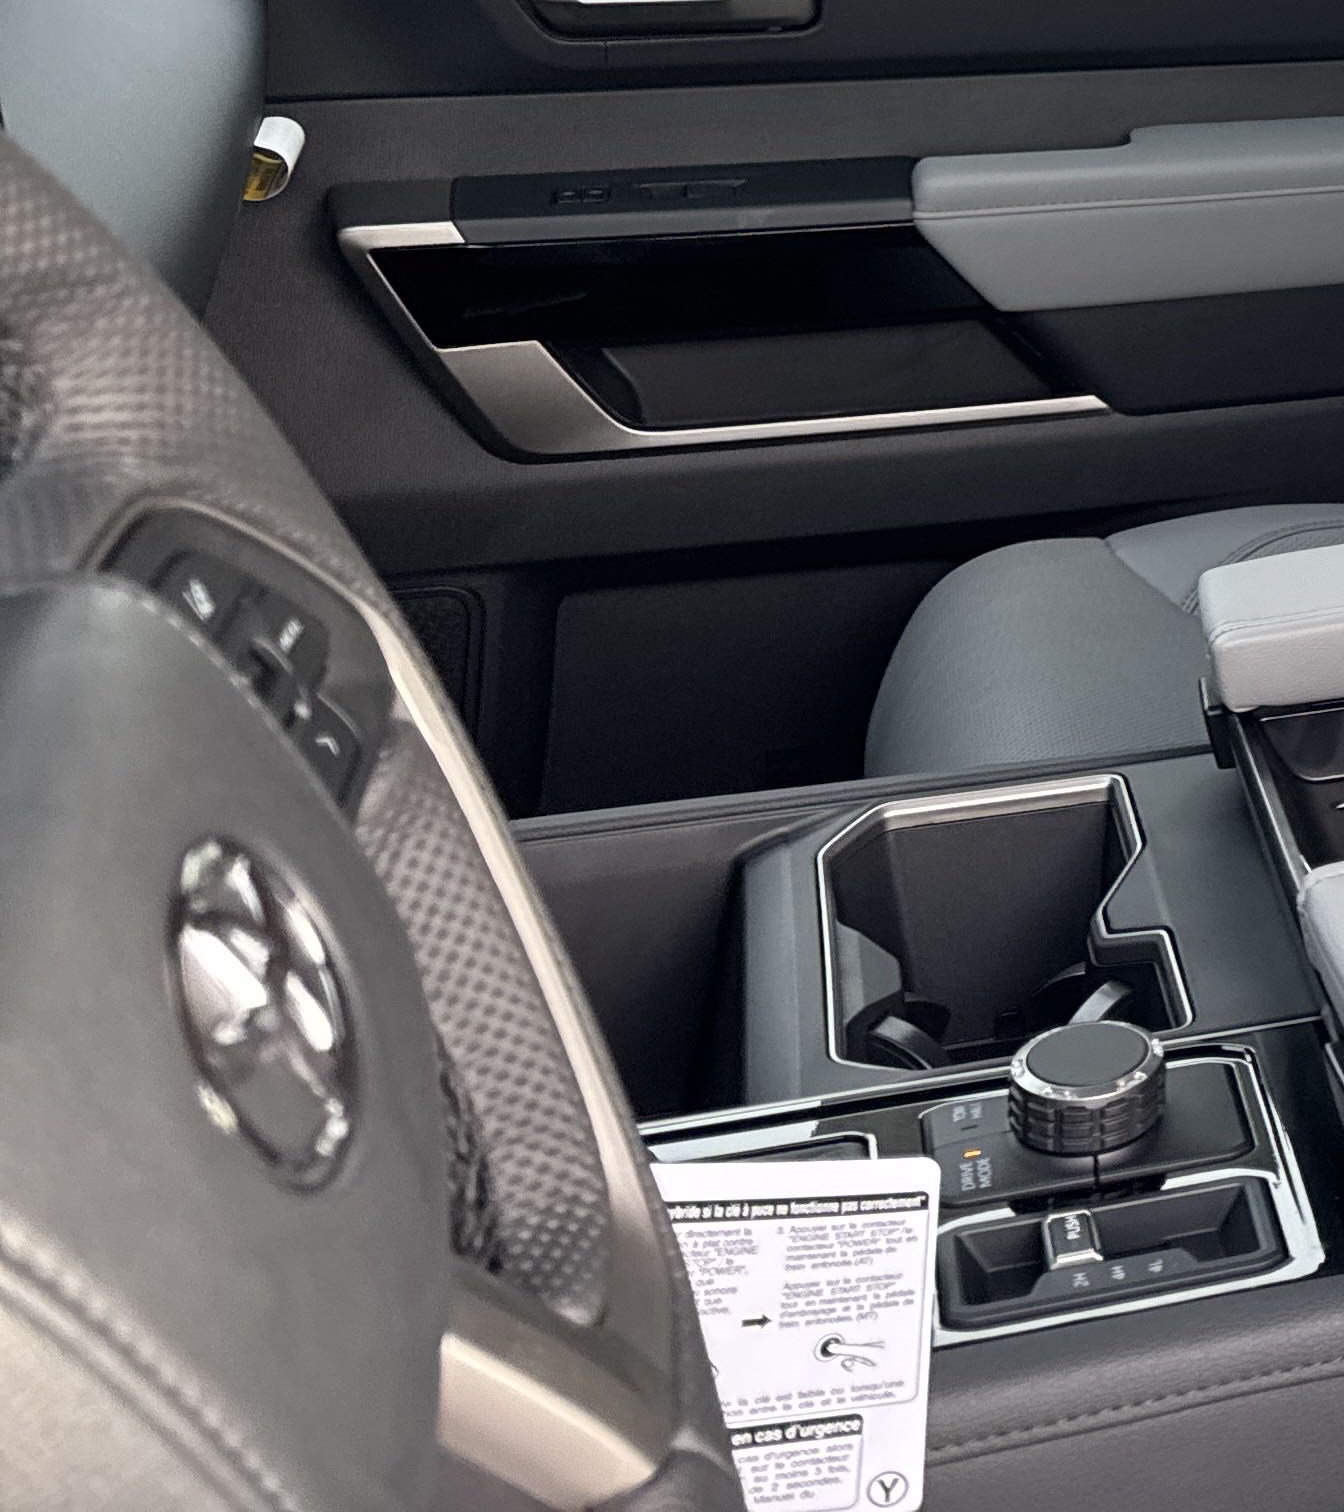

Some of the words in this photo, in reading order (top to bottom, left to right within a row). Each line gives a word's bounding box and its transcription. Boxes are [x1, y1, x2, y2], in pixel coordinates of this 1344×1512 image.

[960, 1162, 974, 1192] DRIVE
[978, 1156, 992, 1190] MODE
[667, 1204, 702, 1220] ybride
[1066, 1215, 1080, 1240] PUSH
[1072, 1271, 1090, 1288] 2H
[1110, 1264, 1126, 1281] 4H
[731, 1432, 752, 1446] en
[754, 1428, 783, 1444] cas
[784, 1419, 862, 1440] d'urgence
[877, 1478, 900, 1503] Y
